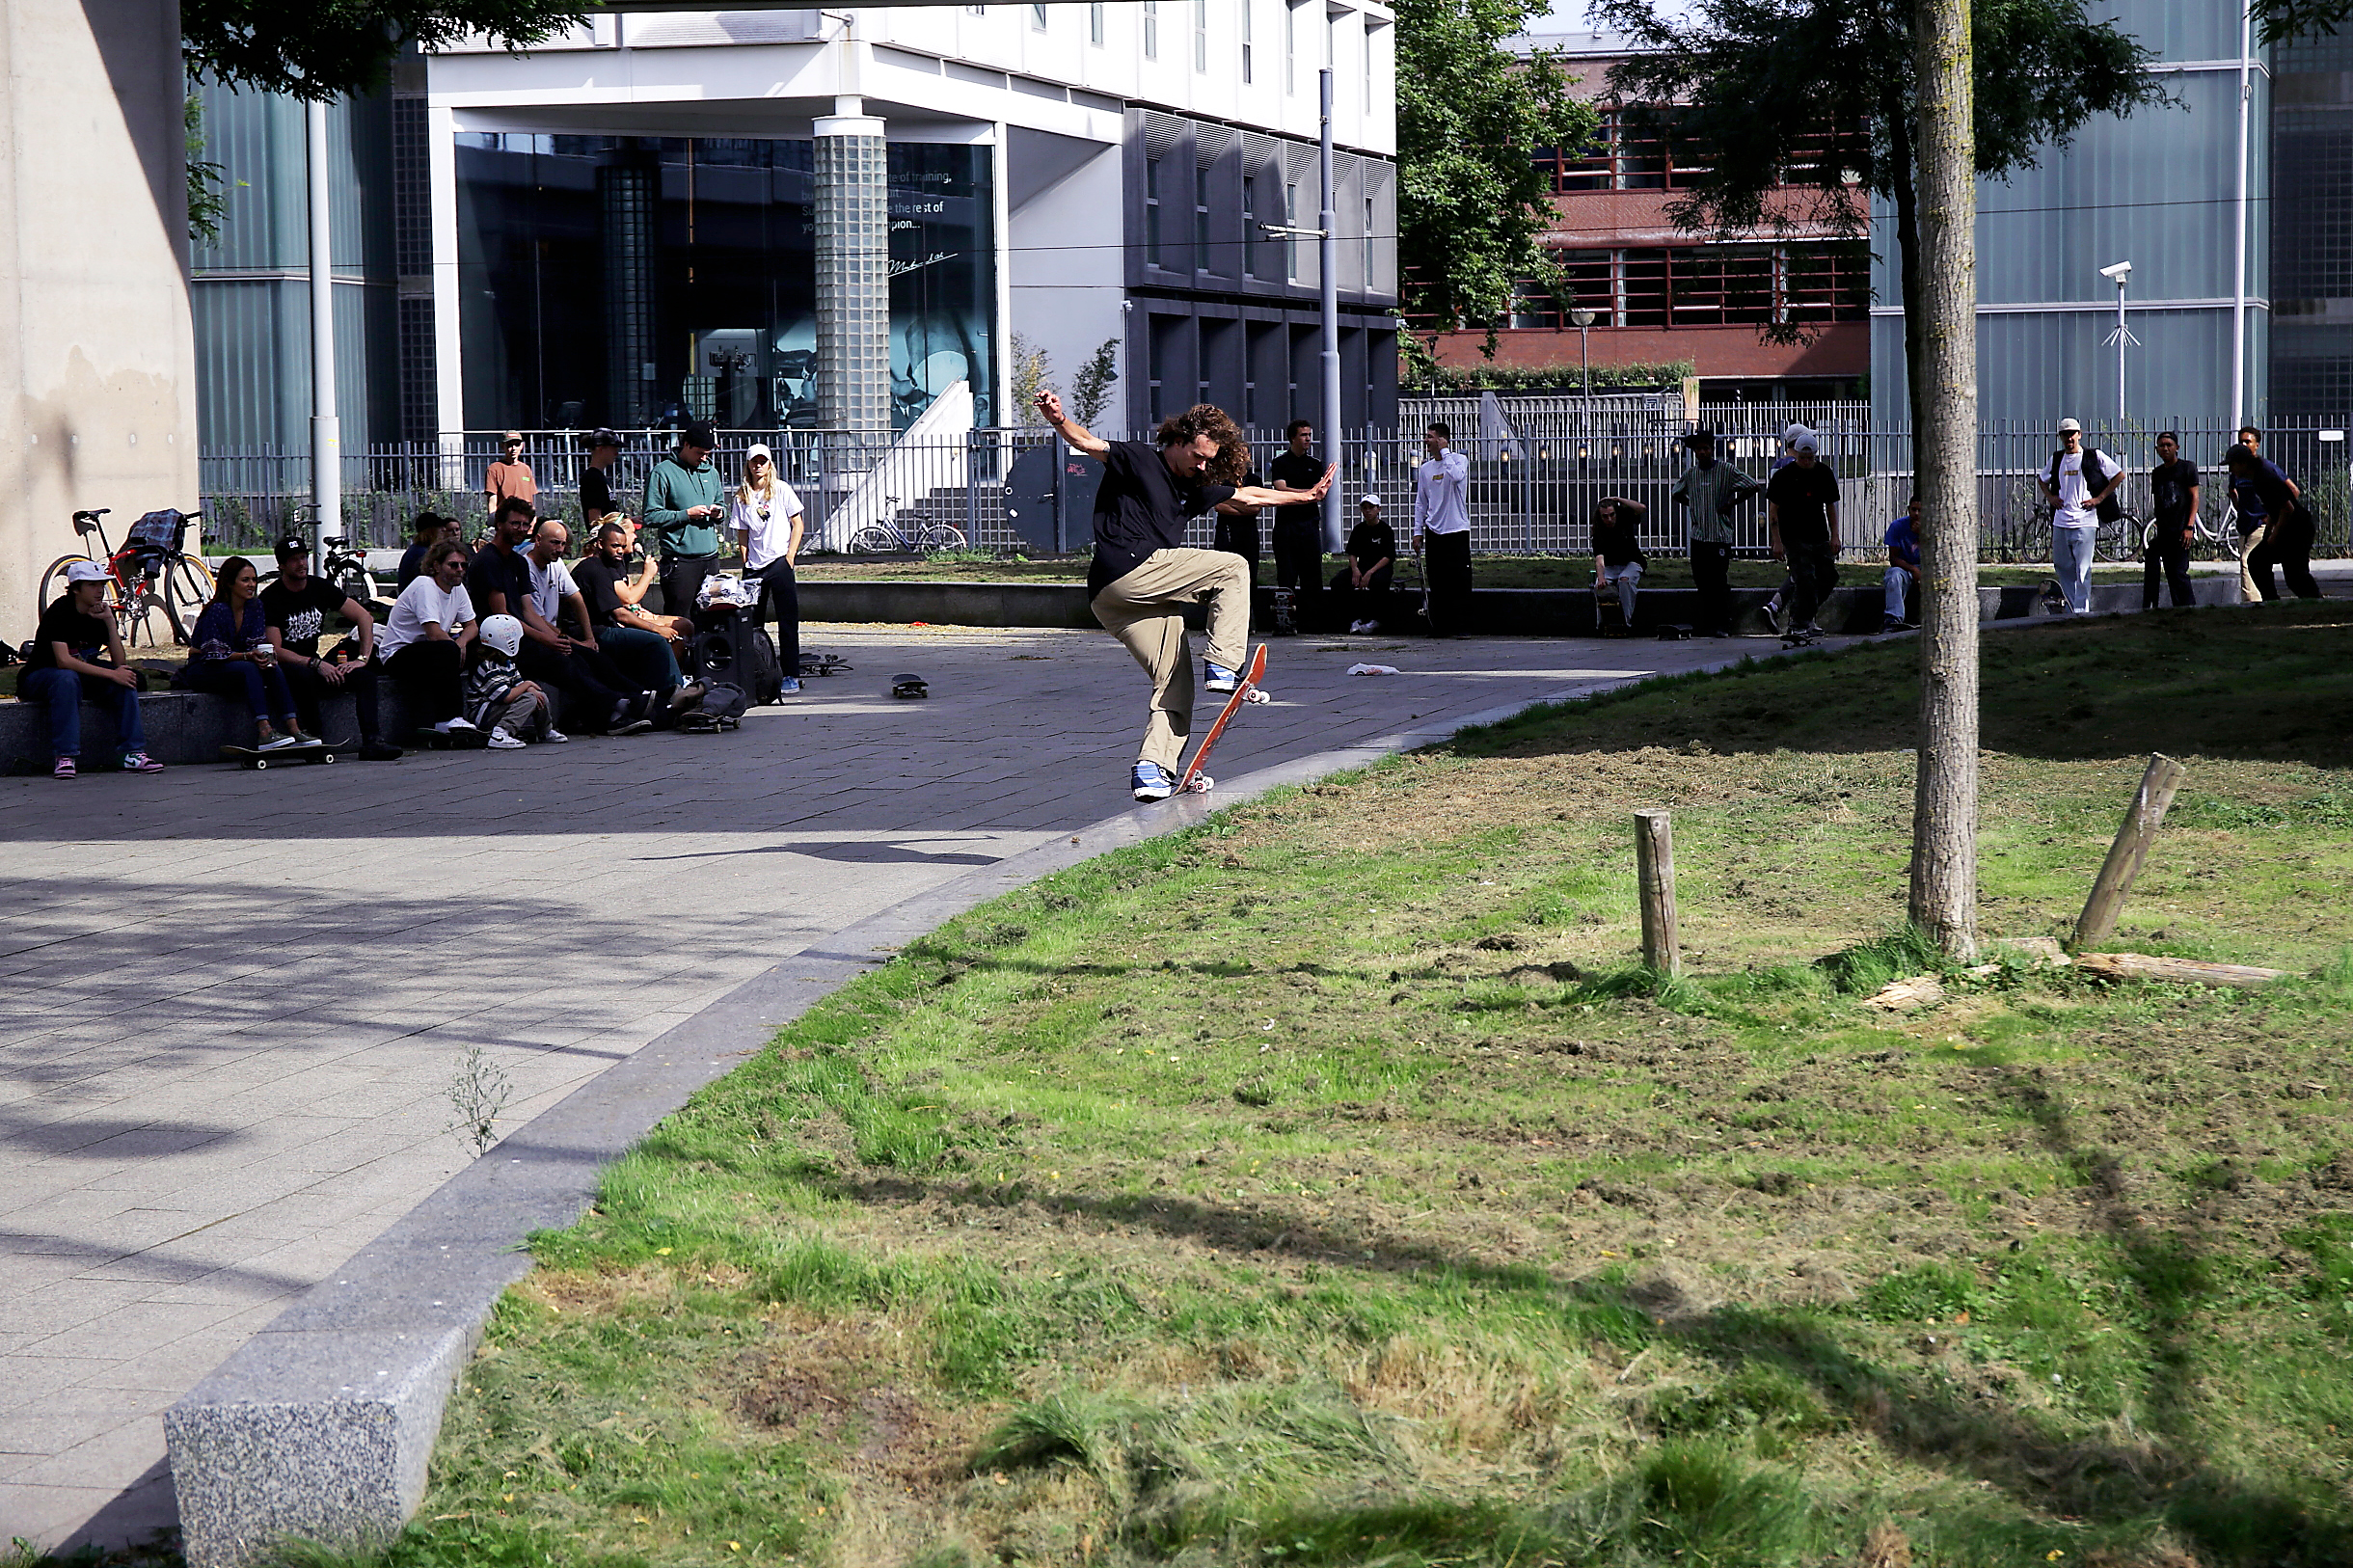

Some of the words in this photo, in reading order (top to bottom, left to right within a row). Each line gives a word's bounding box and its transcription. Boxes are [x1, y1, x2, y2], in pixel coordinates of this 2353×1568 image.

[900, 171, 909, 182] of
[895, 203, 910, 213] the
[912, 202, 932, 213] rest
[933, 201, 944, 213] of
